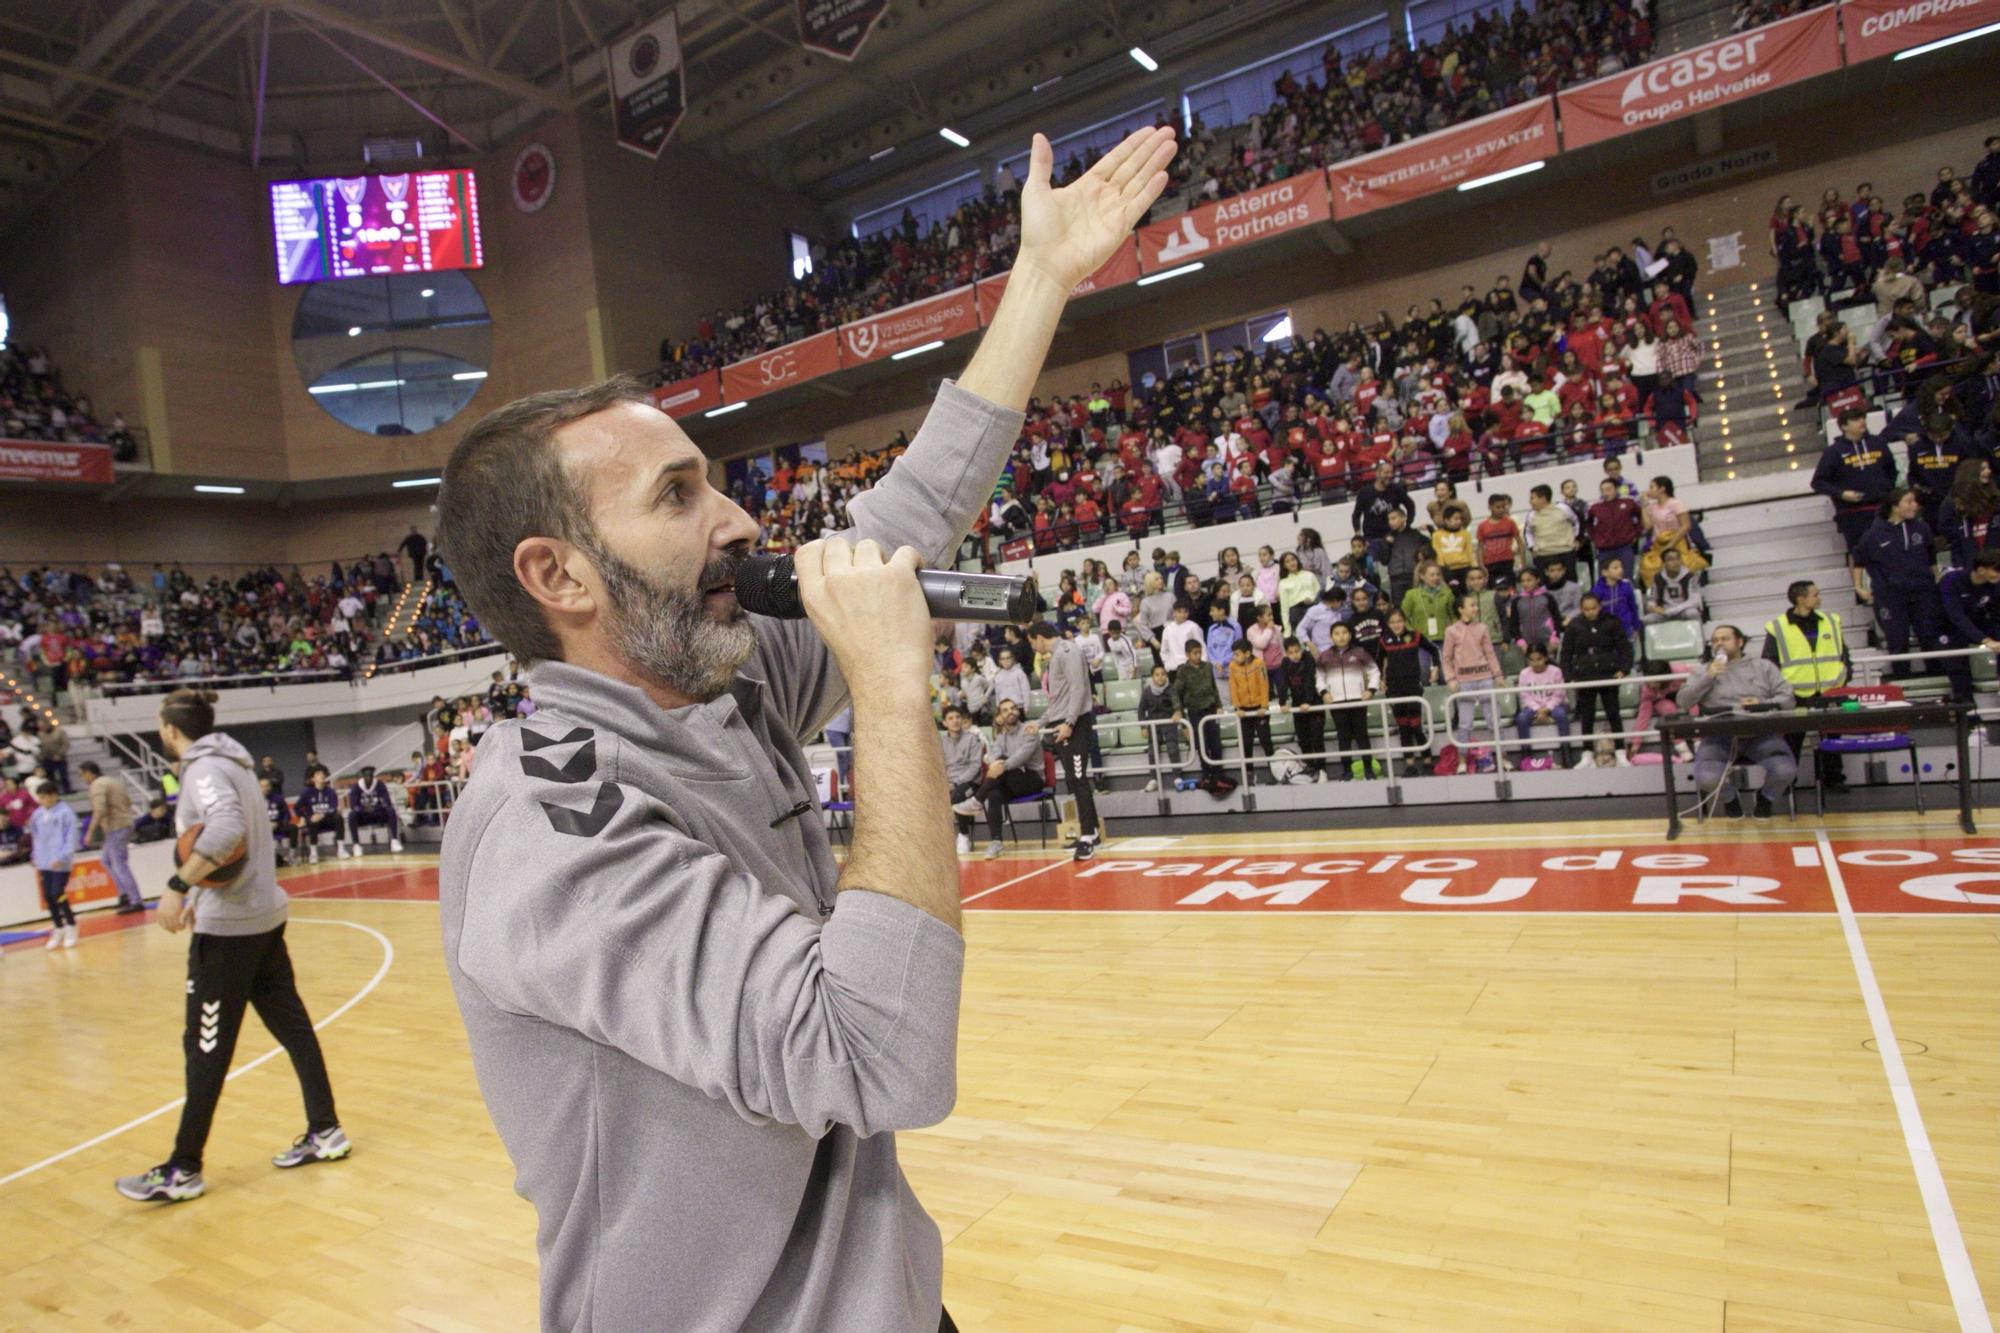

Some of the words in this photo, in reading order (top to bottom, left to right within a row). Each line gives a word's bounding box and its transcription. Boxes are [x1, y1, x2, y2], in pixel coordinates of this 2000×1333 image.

[1647, 33, 1766, 94] caser
[1622, 97, 1684, 127] Grupo
[1687, 71, 1771, 107] Helvetia
[1367, 153, 1451, 190] ESTRELLA
[1464, 123, 1545, 160] LEVANTE
[1214, 184, 1294, 224] Asterra
[1215, 202, 1309, 246] Partners
[1075, 855, 1478, 877] Palacio
[1540, 850, 1710, 870] de
